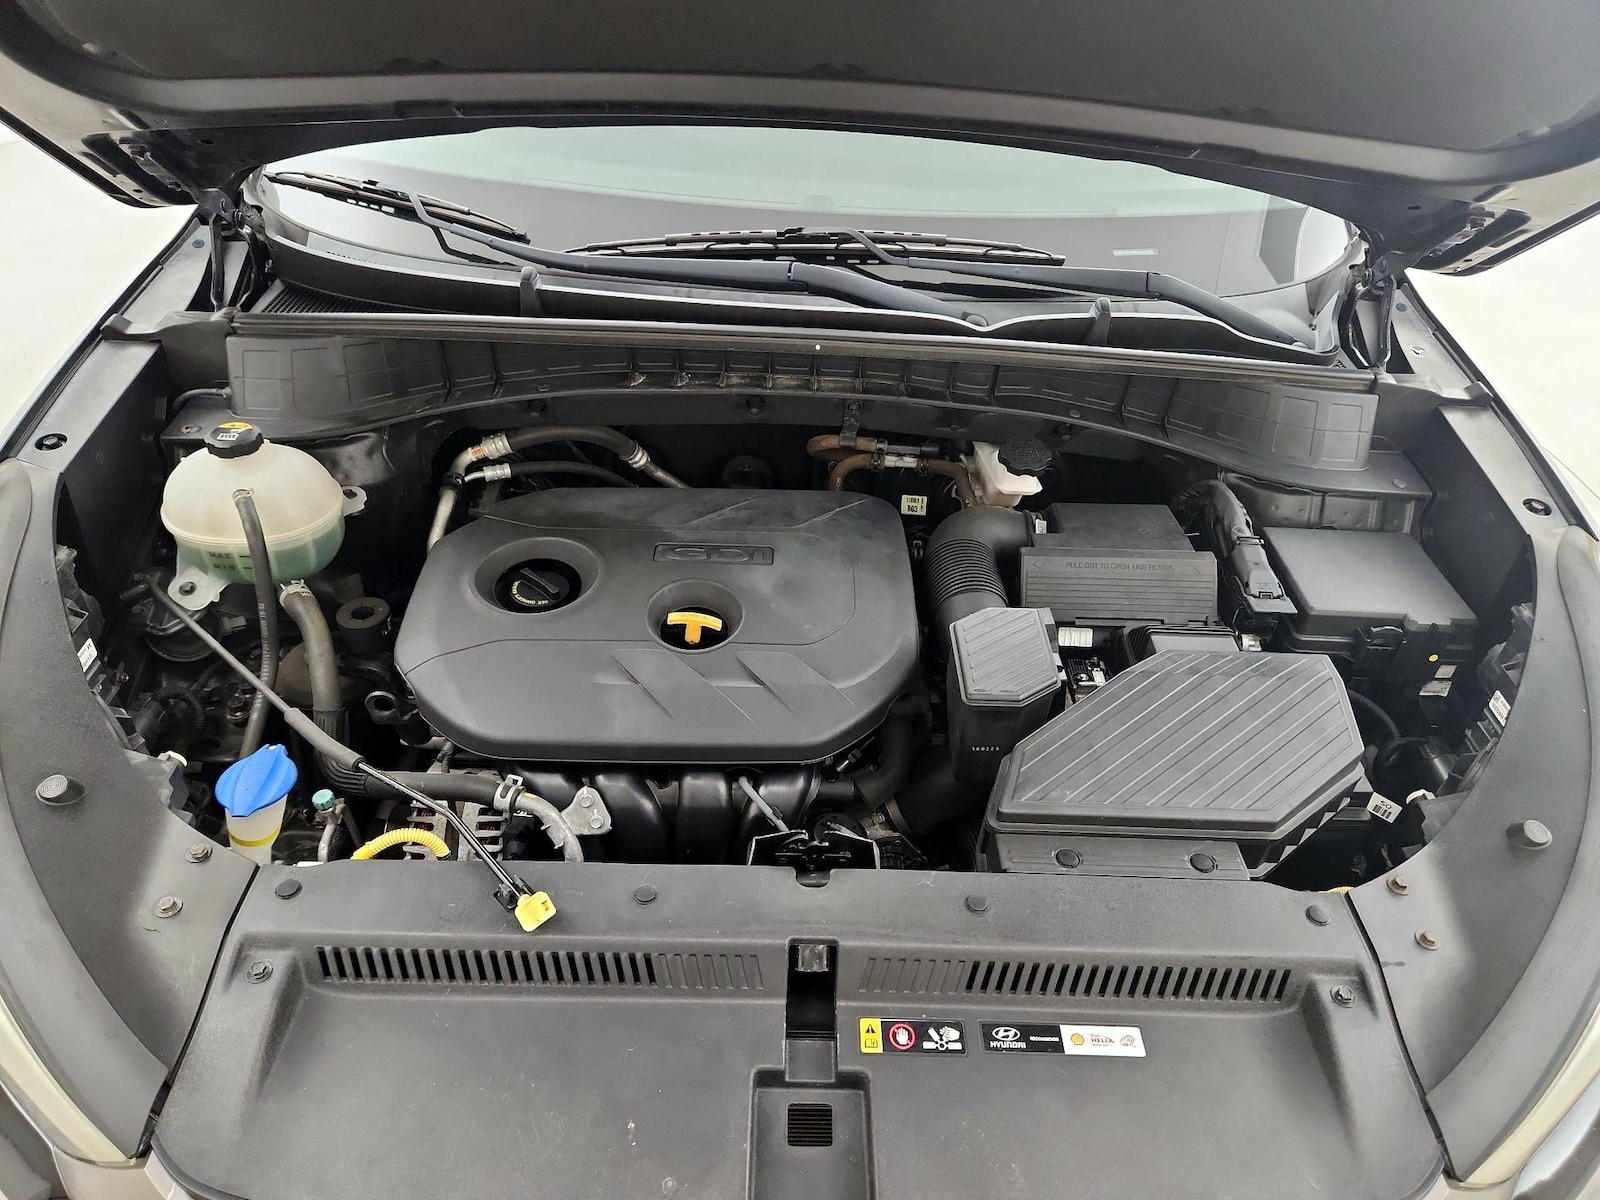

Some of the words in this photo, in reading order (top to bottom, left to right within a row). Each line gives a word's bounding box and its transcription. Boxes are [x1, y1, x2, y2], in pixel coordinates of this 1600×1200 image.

[1065, 561, 1083, 569] PULL
[1084, 562, 1099, 570] OUT
[1101, 562, 1110, 570] TO
[990, 1041, 1027, 1049] HYUNDAI
